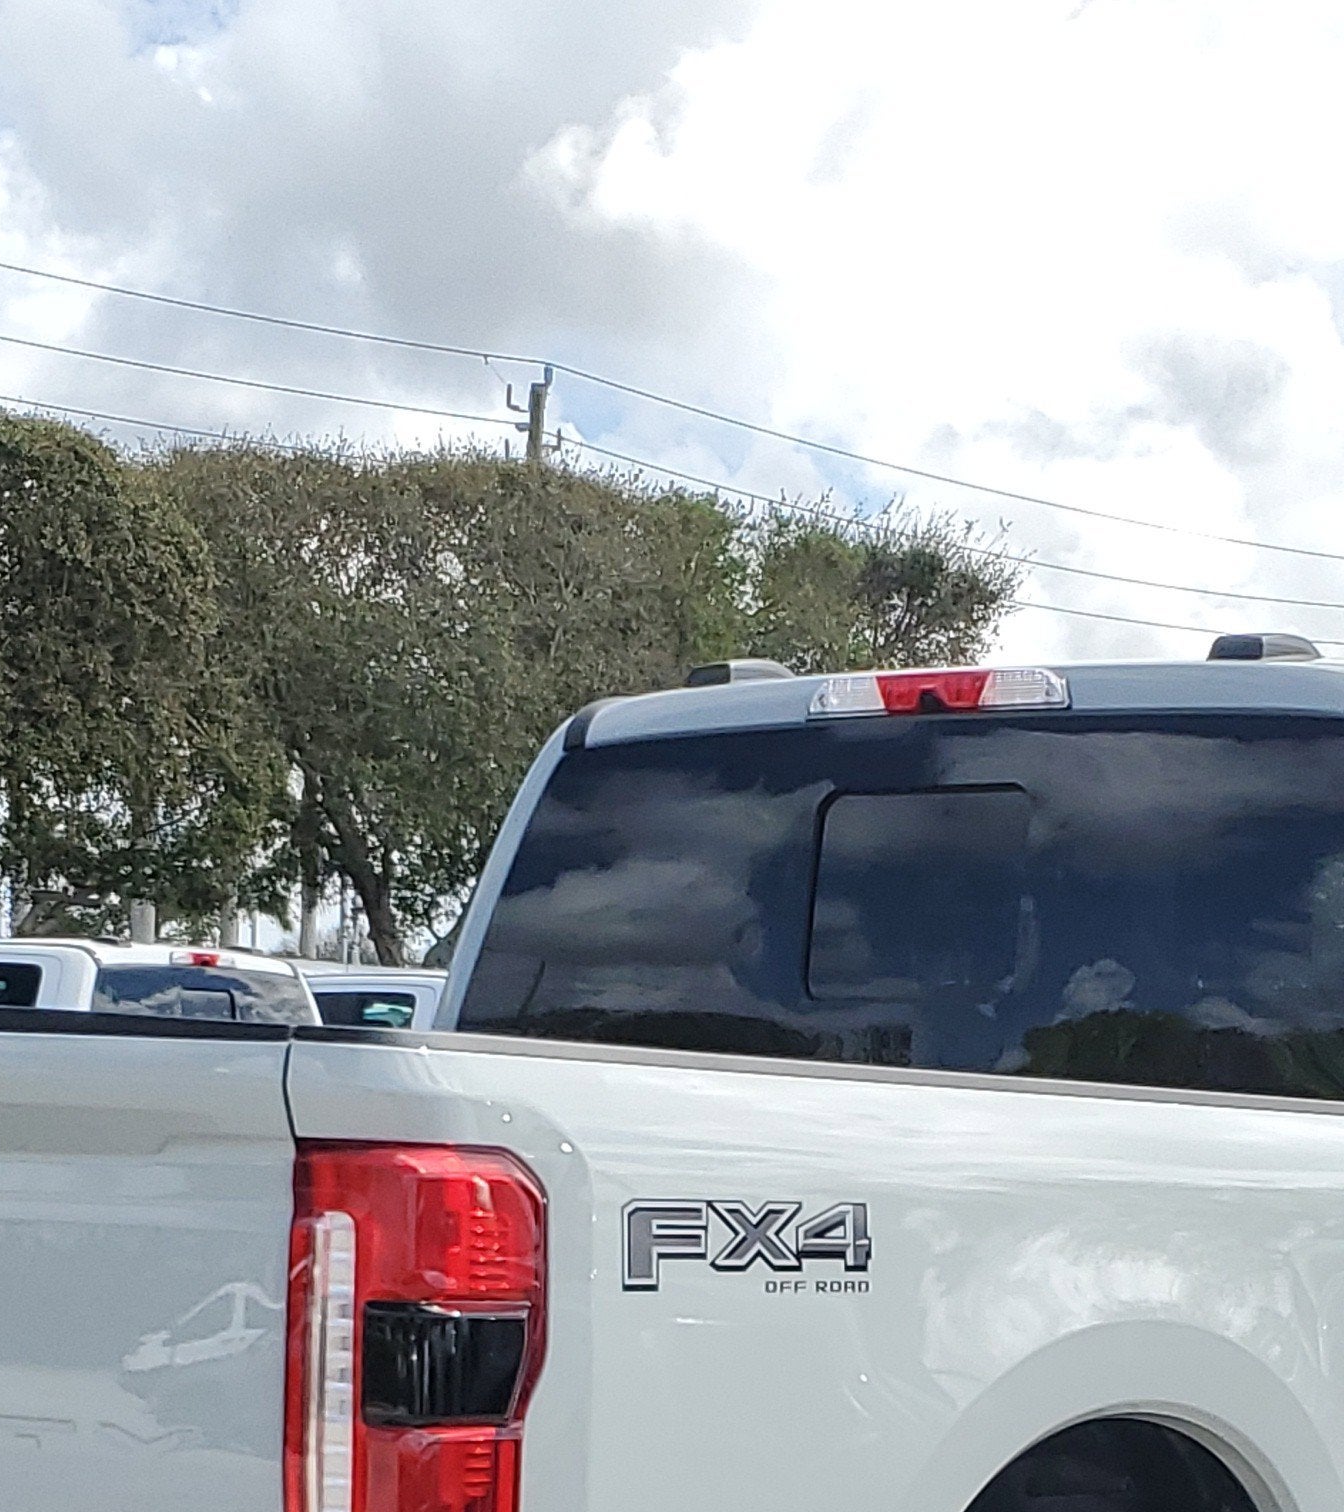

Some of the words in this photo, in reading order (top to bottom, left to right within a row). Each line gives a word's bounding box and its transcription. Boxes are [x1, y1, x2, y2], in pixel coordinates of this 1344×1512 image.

[621, 1198, 872, 1292] FX4
[764, 1280, 807, 1293] OFF
[816, 1280, 870, 1294] ROAD
